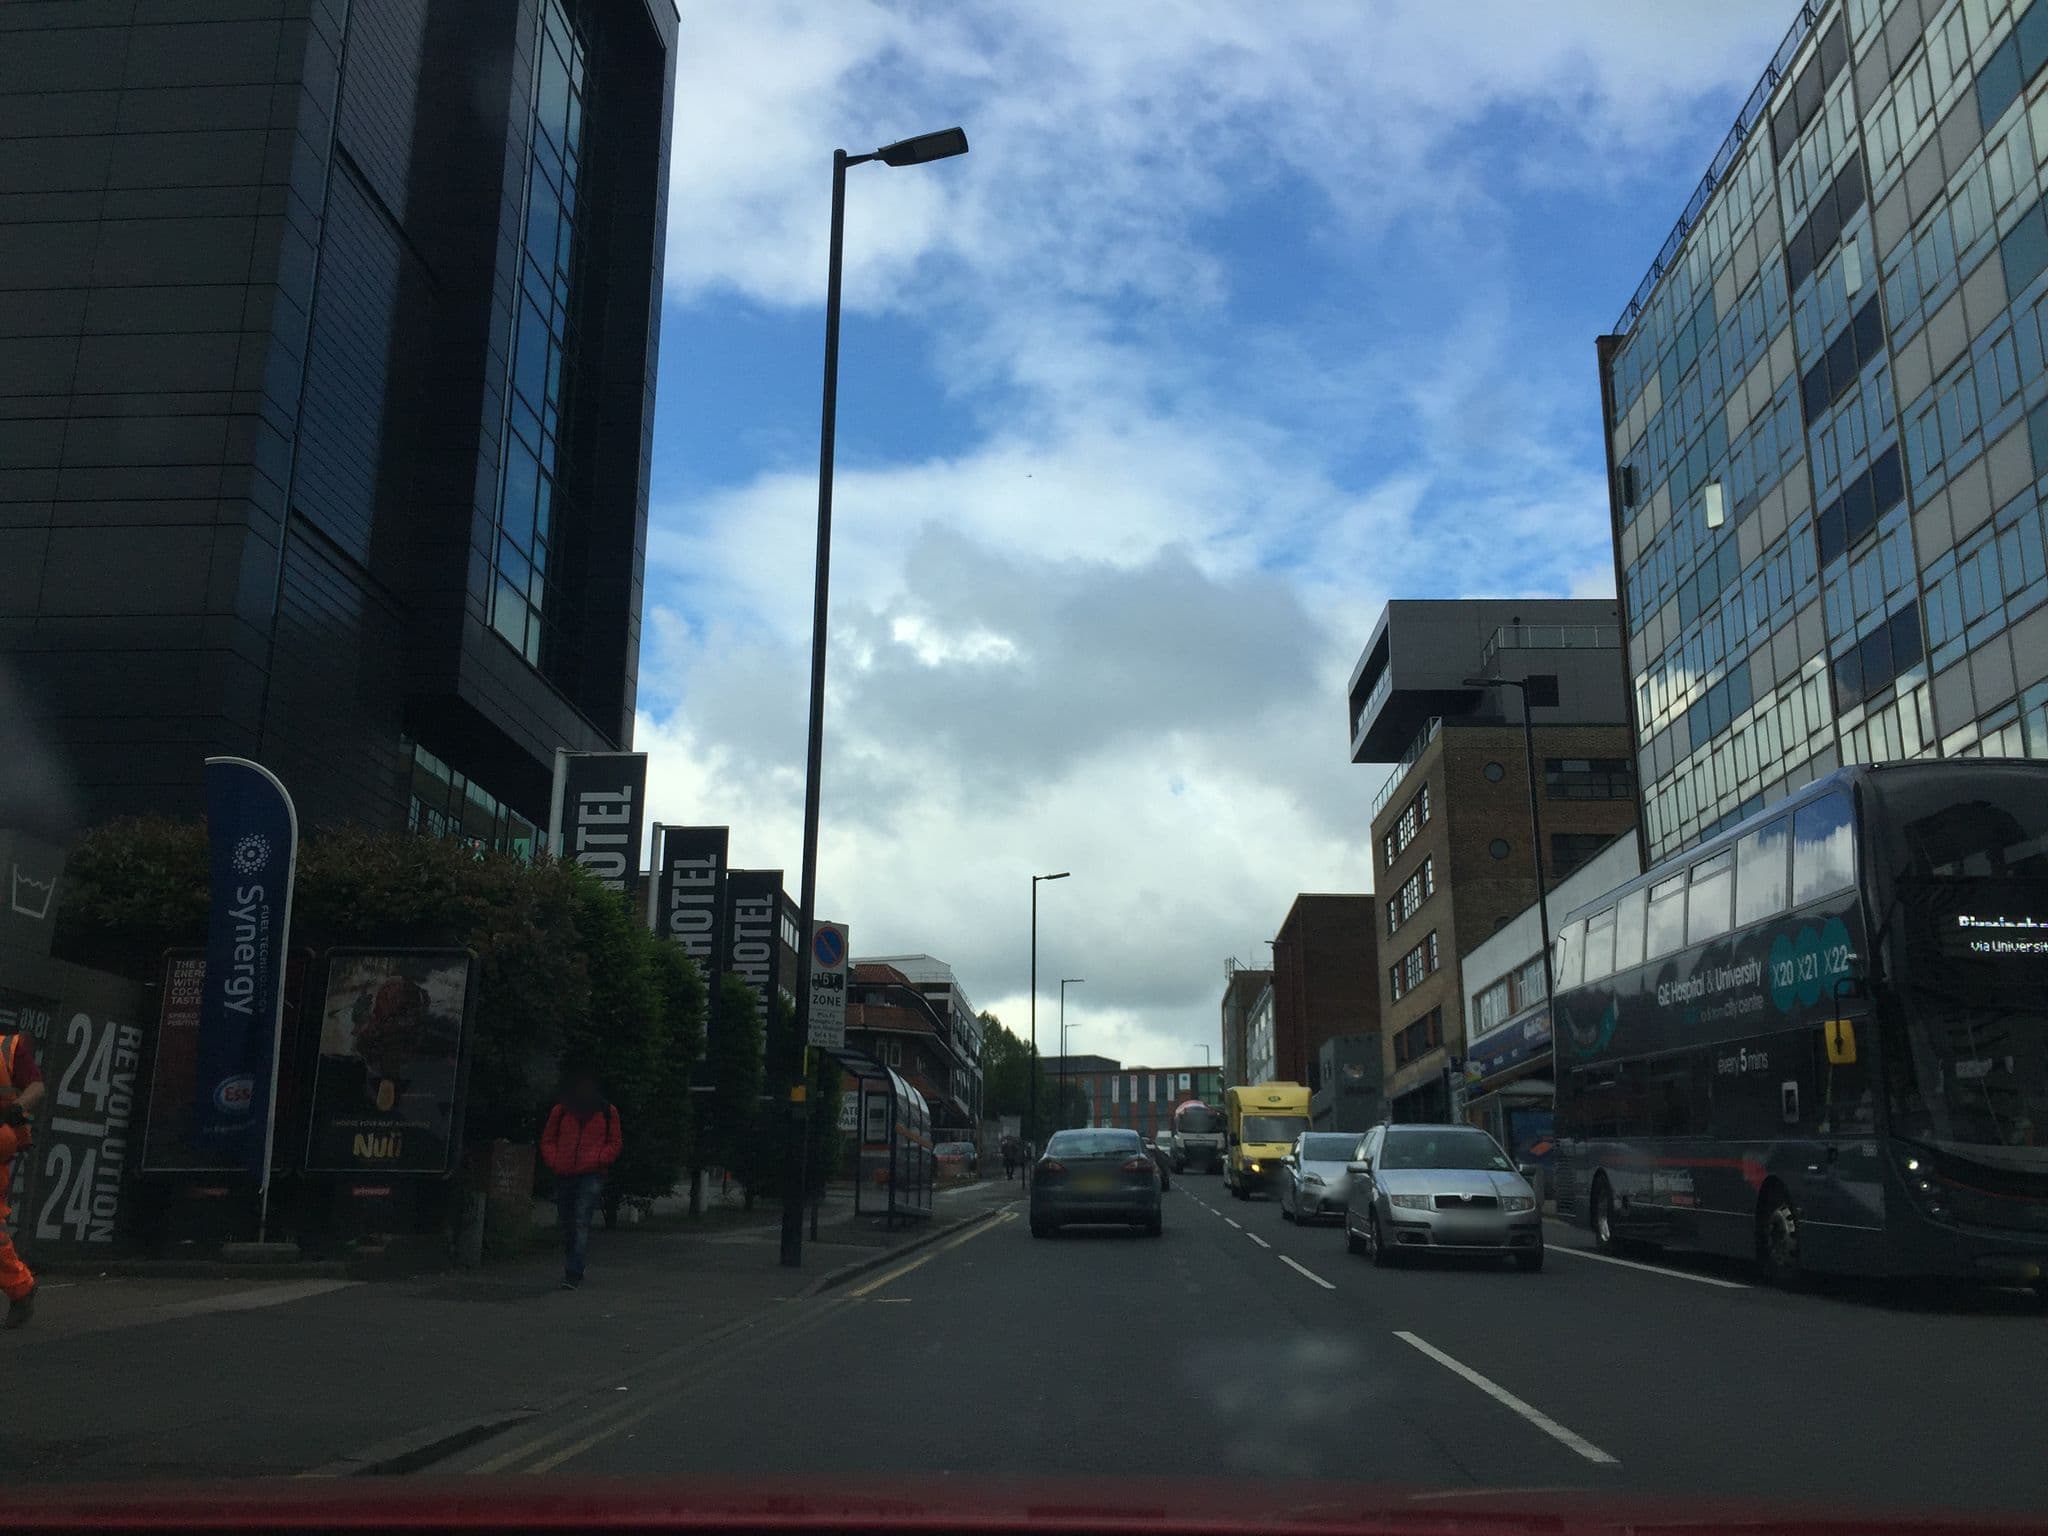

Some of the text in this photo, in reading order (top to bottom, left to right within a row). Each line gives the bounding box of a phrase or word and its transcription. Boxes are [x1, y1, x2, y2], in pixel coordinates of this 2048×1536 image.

[670, 854, 717, 955] HOTEL
[732, 894, 773, 983] HOTEL
[175, 960, 196, 969] THE
[223, 885, 265, 1016] Synergy
[1671, 971, 1705, 1004] Hospital
[1715, 957, 1762, 991] University
[1772, 944, 1849, 987] X20 X21 X22
[1970, 941, 1991, 953] via
[813, 994, 842, 1007] ZONE
[56, 1012, 117, 1112] 24
[1740, 1048, 1747, 1071] 5
[89, 1023, 143, 1242] REVOLUTION
[35, 1143, 97, 1241] 24
